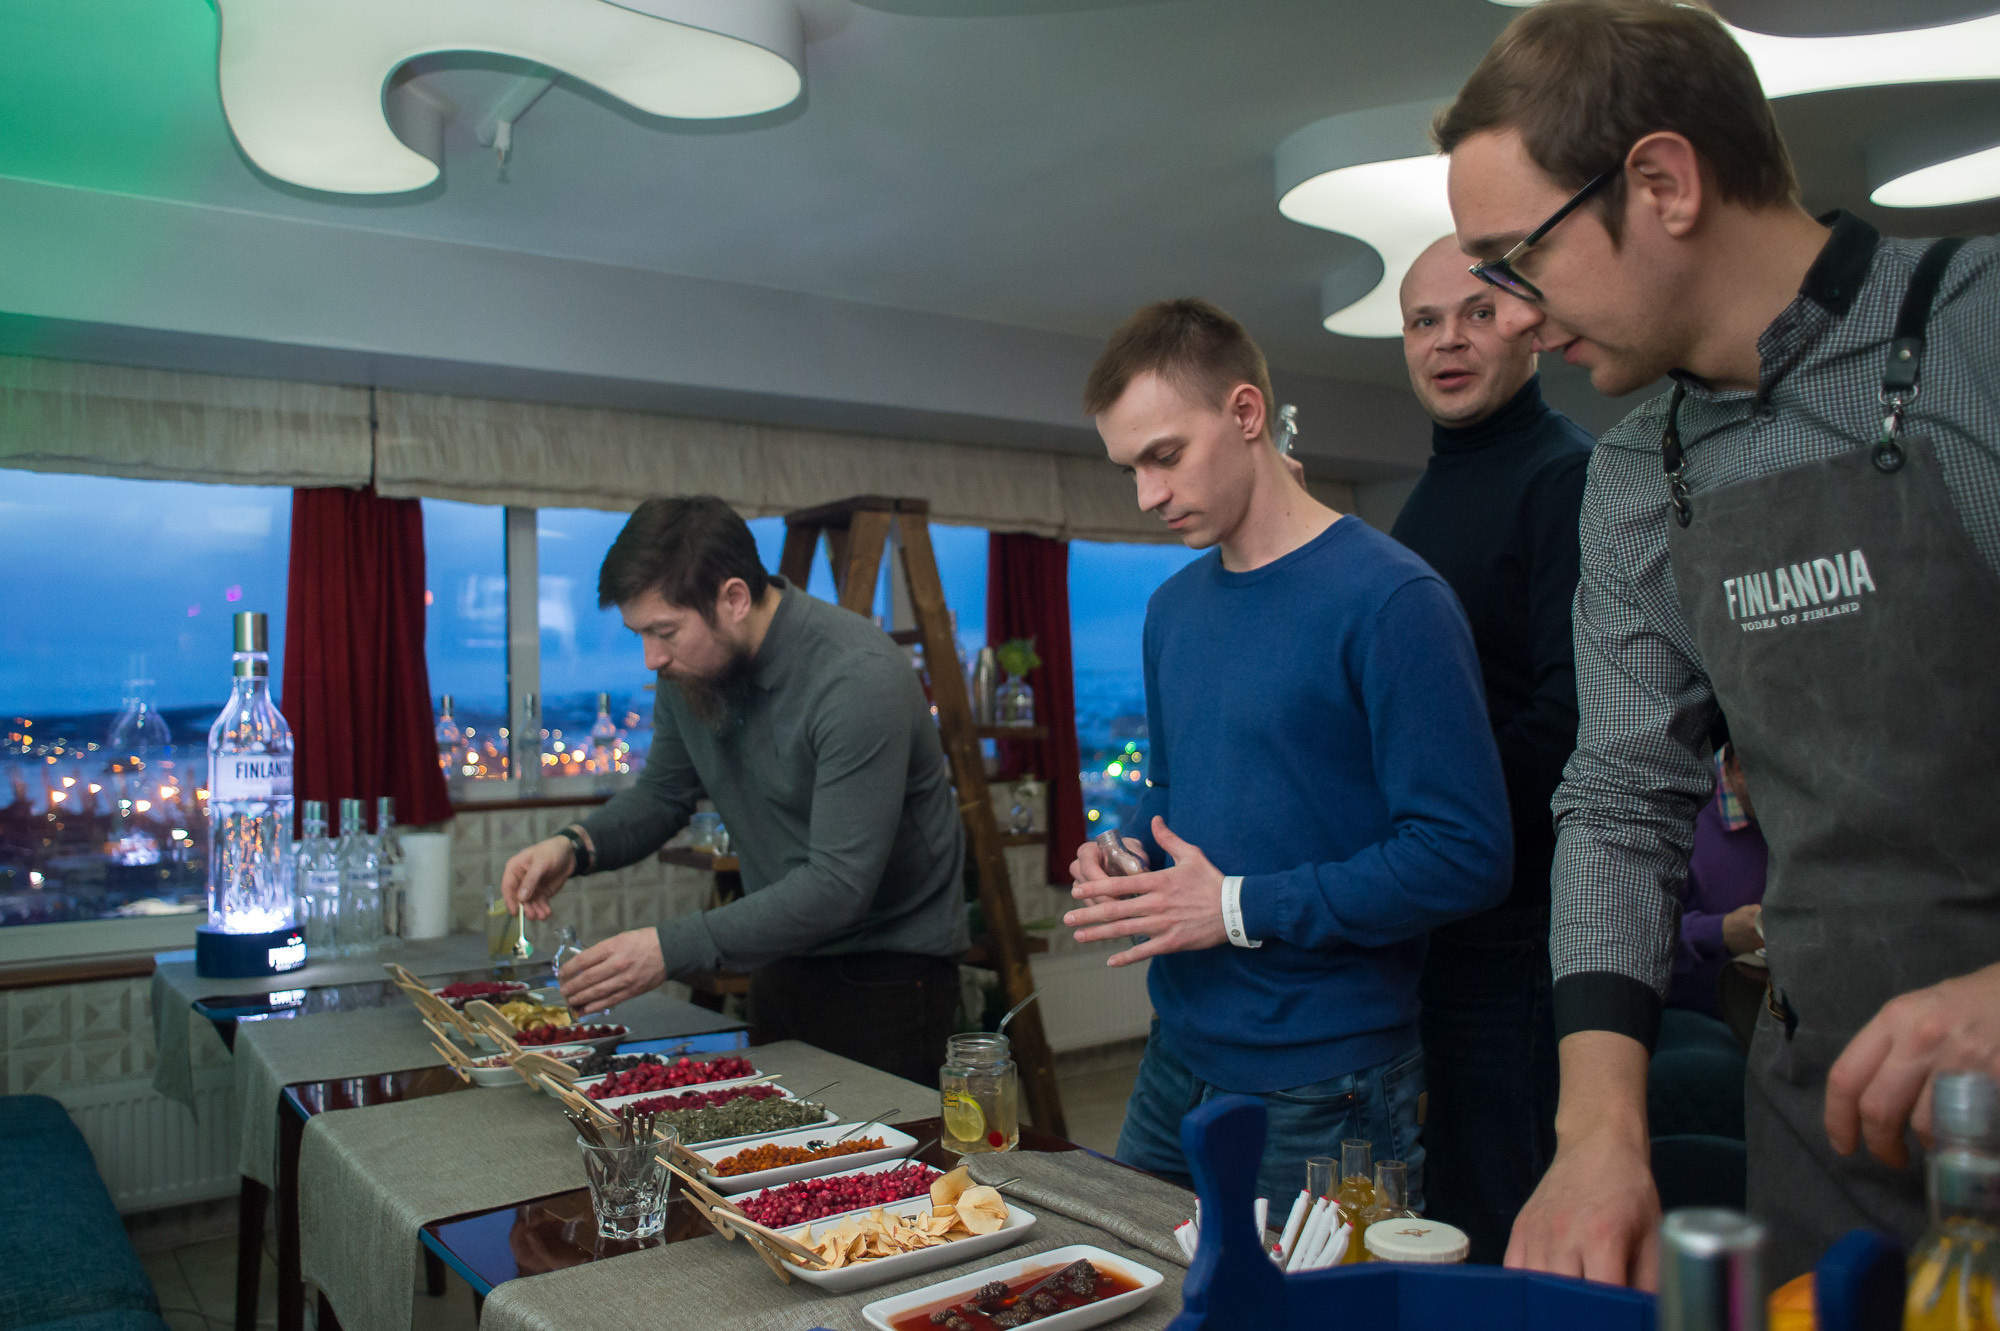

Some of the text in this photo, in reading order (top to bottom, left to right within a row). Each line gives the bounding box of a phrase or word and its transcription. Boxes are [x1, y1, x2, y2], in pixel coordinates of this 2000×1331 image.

[1723, 549, 1876, 620] FINLANDIA
[1740, 602, 1860, 632] VODKA OF FINLAND
